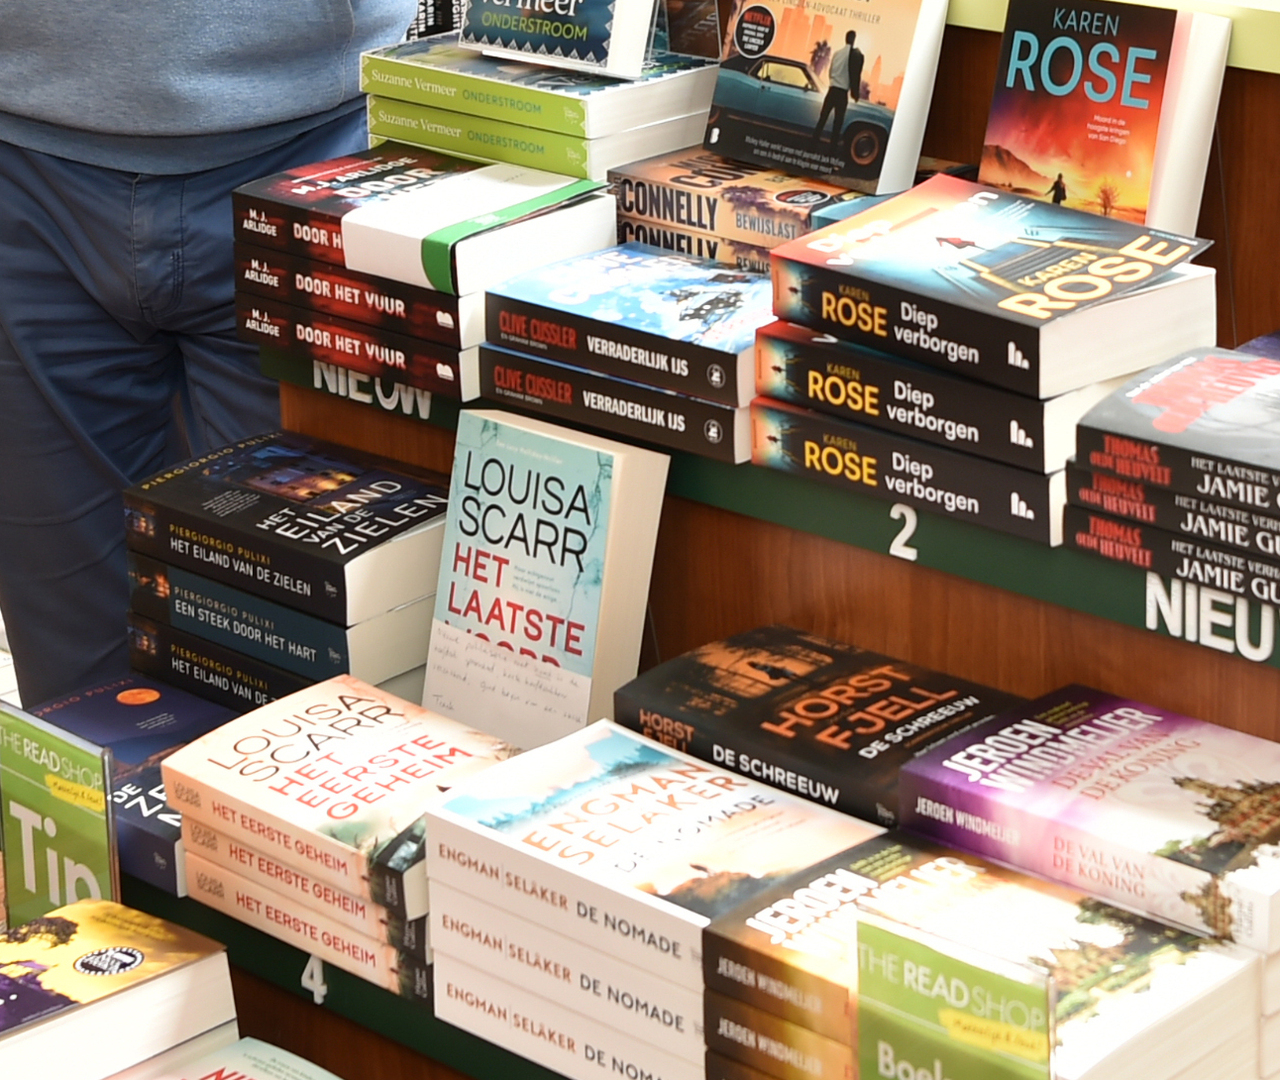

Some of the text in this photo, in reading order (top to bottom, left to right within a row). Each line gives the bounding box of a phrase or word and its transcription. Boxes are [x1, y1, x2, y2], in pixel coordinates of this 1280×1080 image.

[482, 11, 587, 40] ONDERSTROOM
[850, 9, 880, 24] THRILLER
[1052, 7, 1119, 36] KAREN
[370, 68, 542, 116] Suzanne Vermeer ONDERSTROOM
[1005, 31, 1157, 109] ROSE
[245, 267, 279, 288] ARLIDGE
[295, 274, 405, 318] DOOR HET VUUR
[822, 291, 888, 338] ROSE
[901, 301, 938, 331] Diep
[499, 310, 689, 377] CLIVE CUSSLER VERRADERLIJK IJS
[894, 327, 979, 365] verborgen
[464, 450, 591, 525] LOUISA
[1196, 474, 1272, 510] JAMIE
[169, 524, 271, 566] PIERGIORGIO PULIXI
[459, 495, 588, 573] SCARR
[889, 503, 917, 560] 2
[170, 539, 311, 596] HET EILAND VAN DE ZIELEN
[453, 543, 509, 587] HET
[448, 582, 585, 656] LAATSTE
[759, 665, 914, 739] HORST
[823, 684, 958, 753] FJELL
[23, 738, 60, 773] READ
[61, 756, 102, 787] SHOP
[712, 743, 839, 804] DE SCHREEUW
[942, 719, 1063, 782] JEROEN
[980, 707, 1164, 793] WINDMEIJER
[9, 801, 102, 900] Tip
[212, 801, 349, 876] HET EERSTE GEHEIM
[438, 842, 500, 882] ENGMAN
[504, 870, 569, 912] SELÅKER
[576, 899, 599, 920] DE
[603, 911, 682, 960] NOMADE
